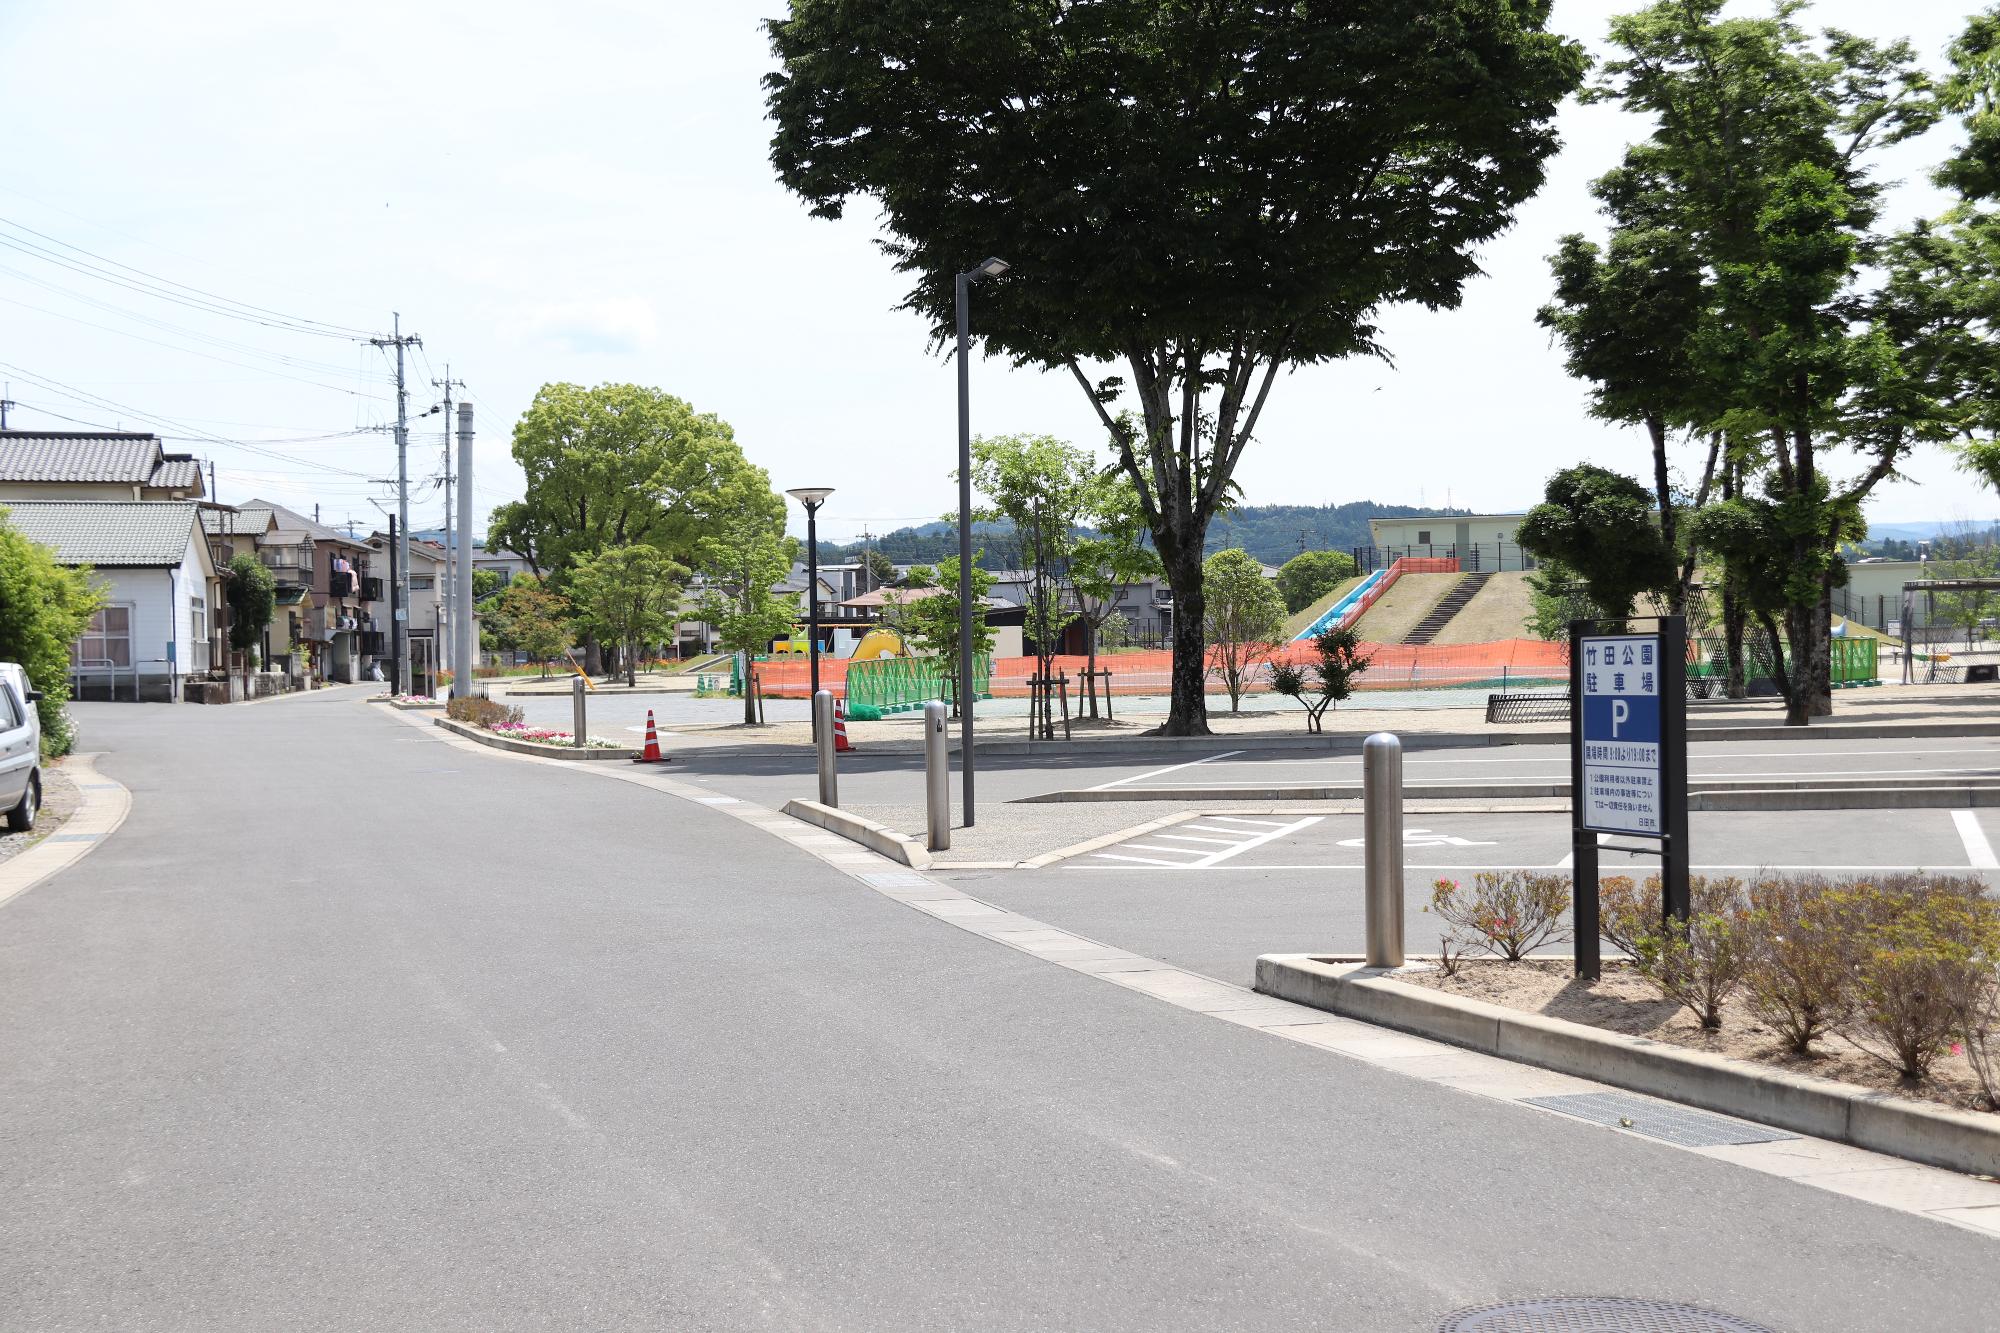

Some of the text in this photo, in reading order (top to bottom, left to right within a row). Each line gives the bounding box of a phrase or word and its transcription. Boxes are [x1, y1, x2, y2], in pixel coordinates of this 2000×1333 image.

[1586, 645, 1653, 666] 竹田公園
[1586, 672, 1653, 693] 駐車場
[1612, 699, 1629, 738] P
